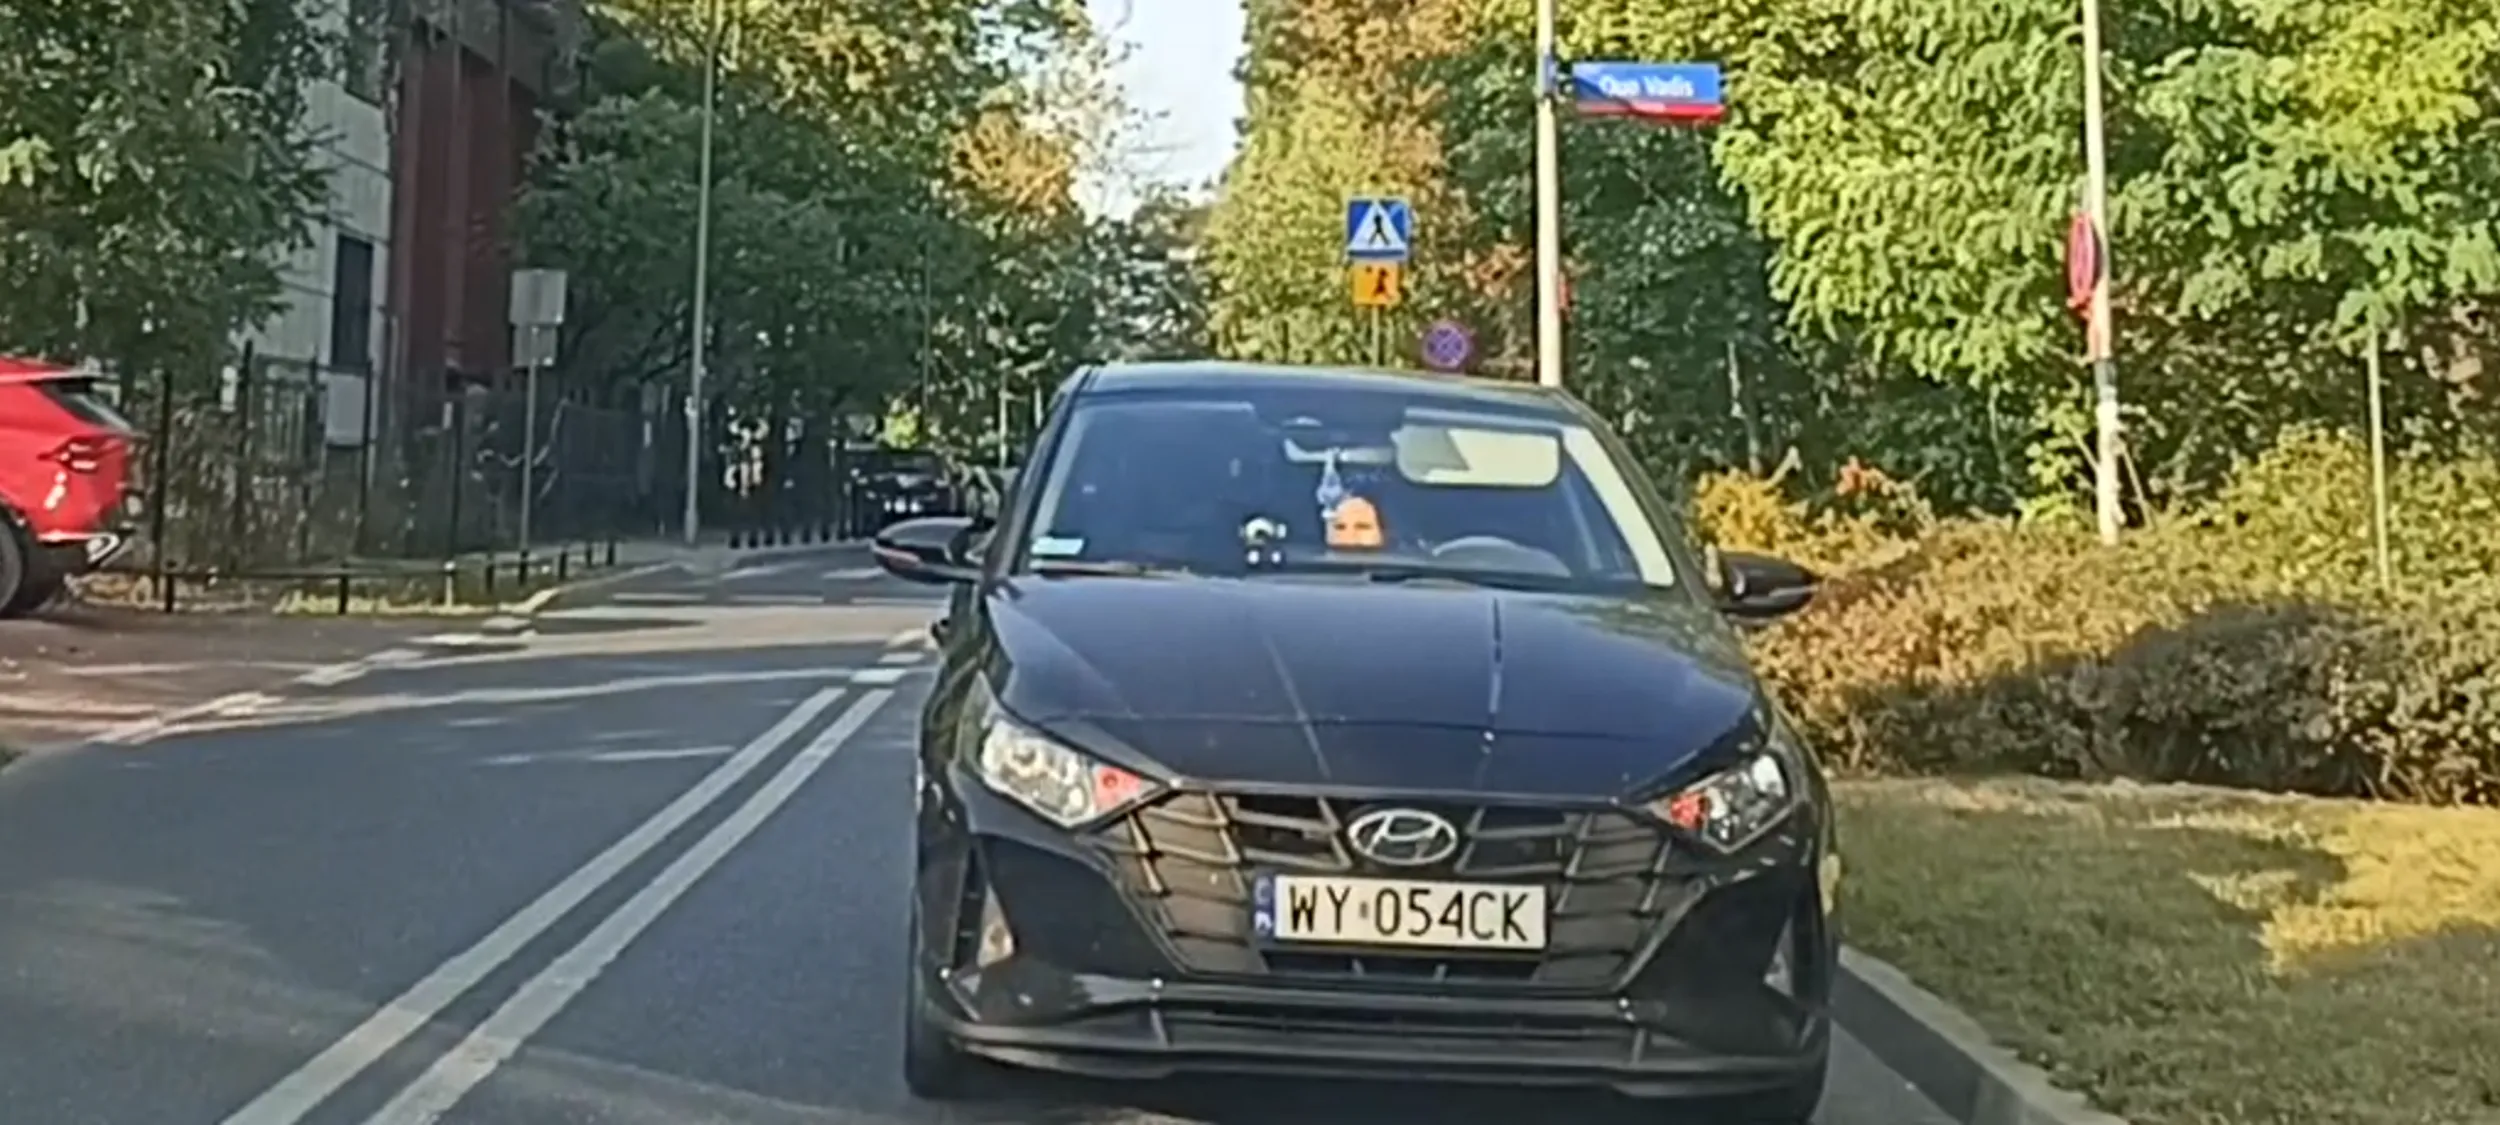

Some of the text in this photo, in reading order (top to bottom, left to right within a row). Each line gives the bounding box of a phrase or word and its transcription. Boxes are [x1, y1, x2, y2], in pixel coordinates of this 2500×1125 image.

[1642, 74, 1694, 97] Vadis
[1288, 884, 1352, 934] WY
[1374, 887, 1530, 943] 054CK
